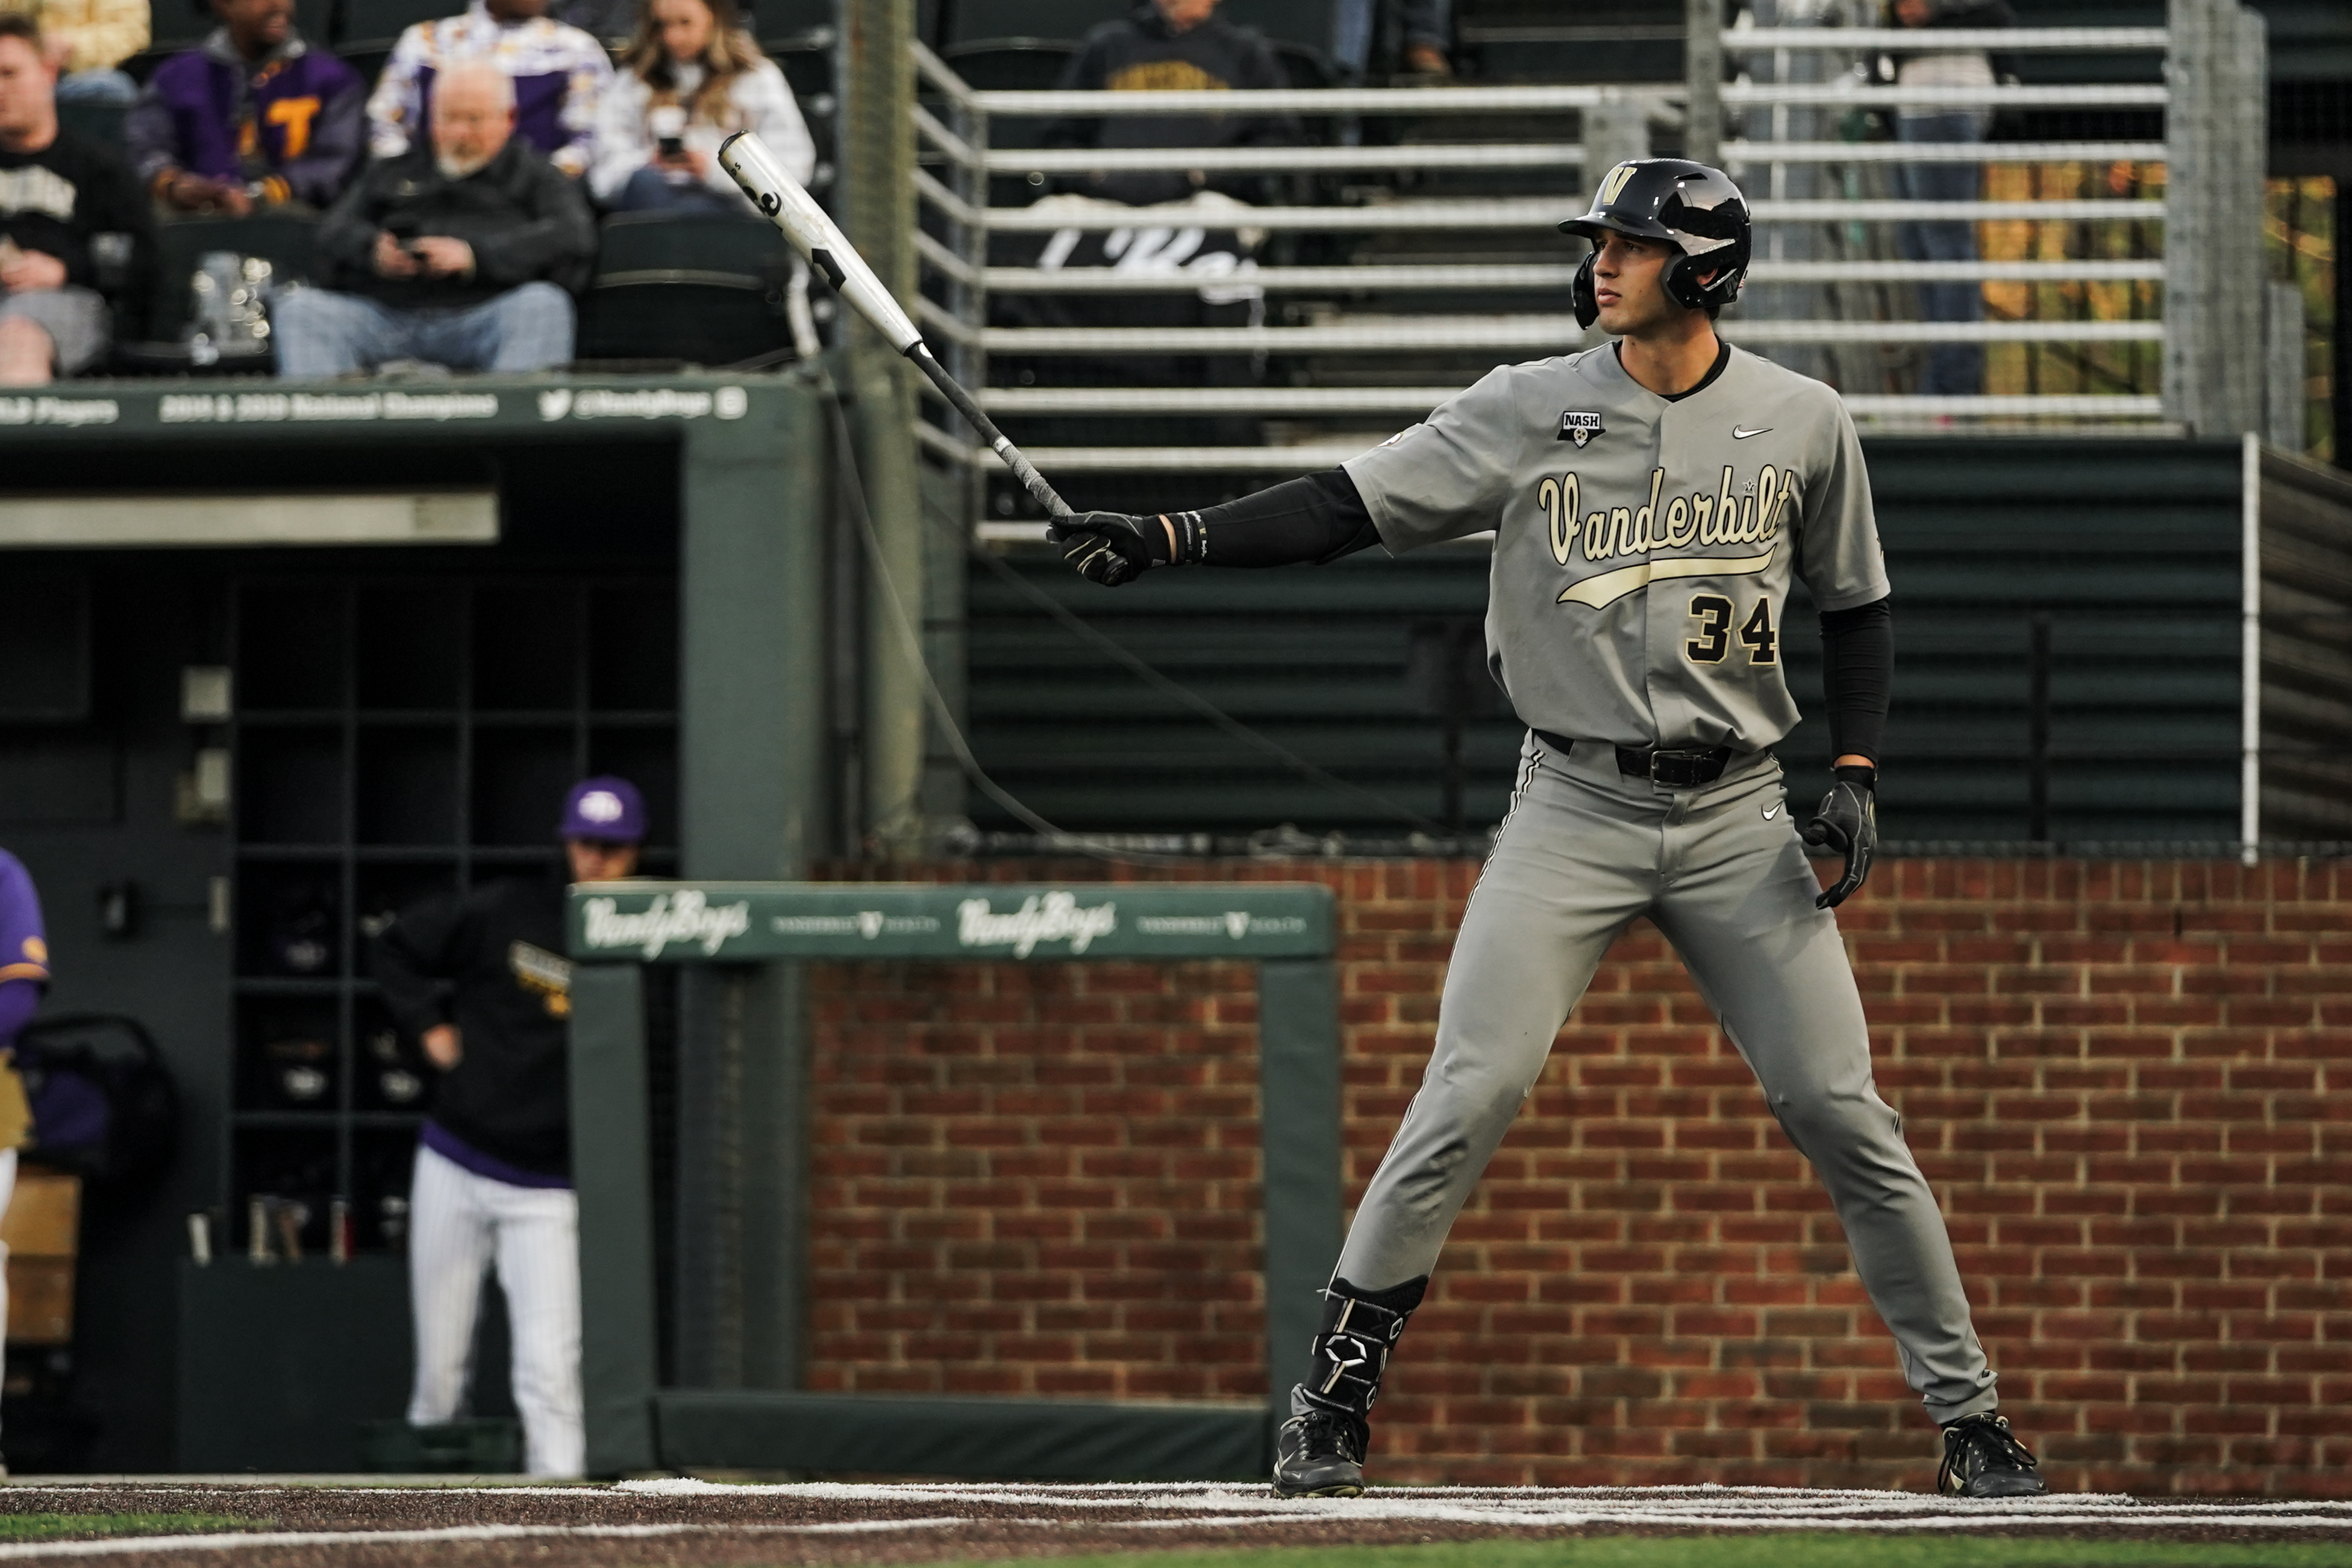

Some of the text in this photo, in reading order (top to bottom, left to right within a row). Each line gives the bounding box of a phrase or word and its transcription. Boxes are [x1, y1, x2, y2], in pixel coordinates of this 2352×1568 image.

[265, 94, 322, 159] T
[1603, 166, 1638, 205] V
[1565, 414, 1599, 426] NASH
[1538, 464, 1794, 566] Vanderbilt
[1684, 593, 1778, 665] 34
